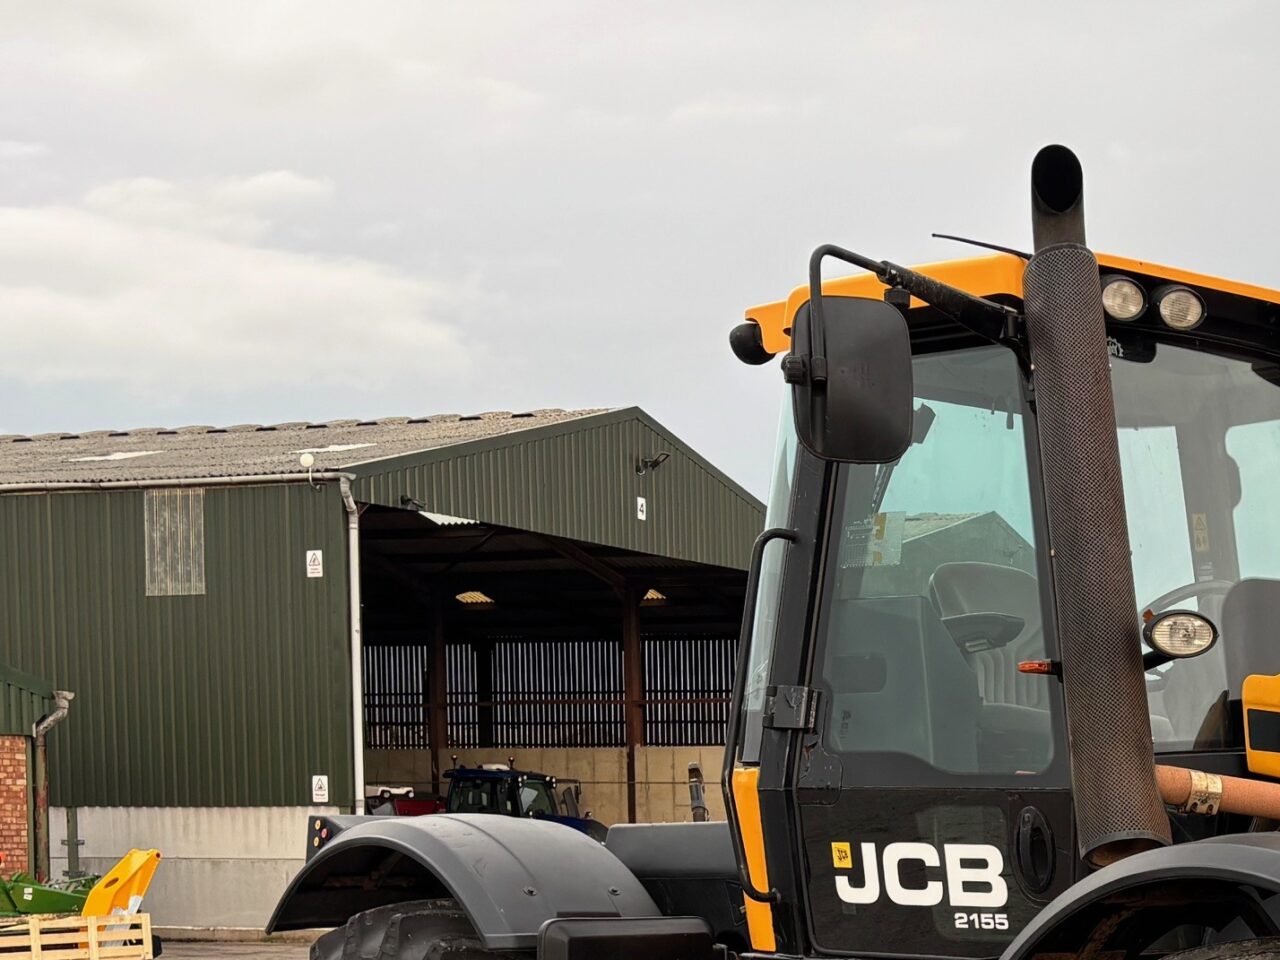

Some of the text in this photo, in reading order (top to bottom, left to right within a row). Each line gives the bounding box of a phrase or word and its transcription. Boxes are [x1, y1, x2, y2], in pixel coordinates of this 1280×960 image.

[639, 502, 645, 516] 4
[833, 842, 1009, 907] JCB
[954, 913, 1009, 930] 2155
